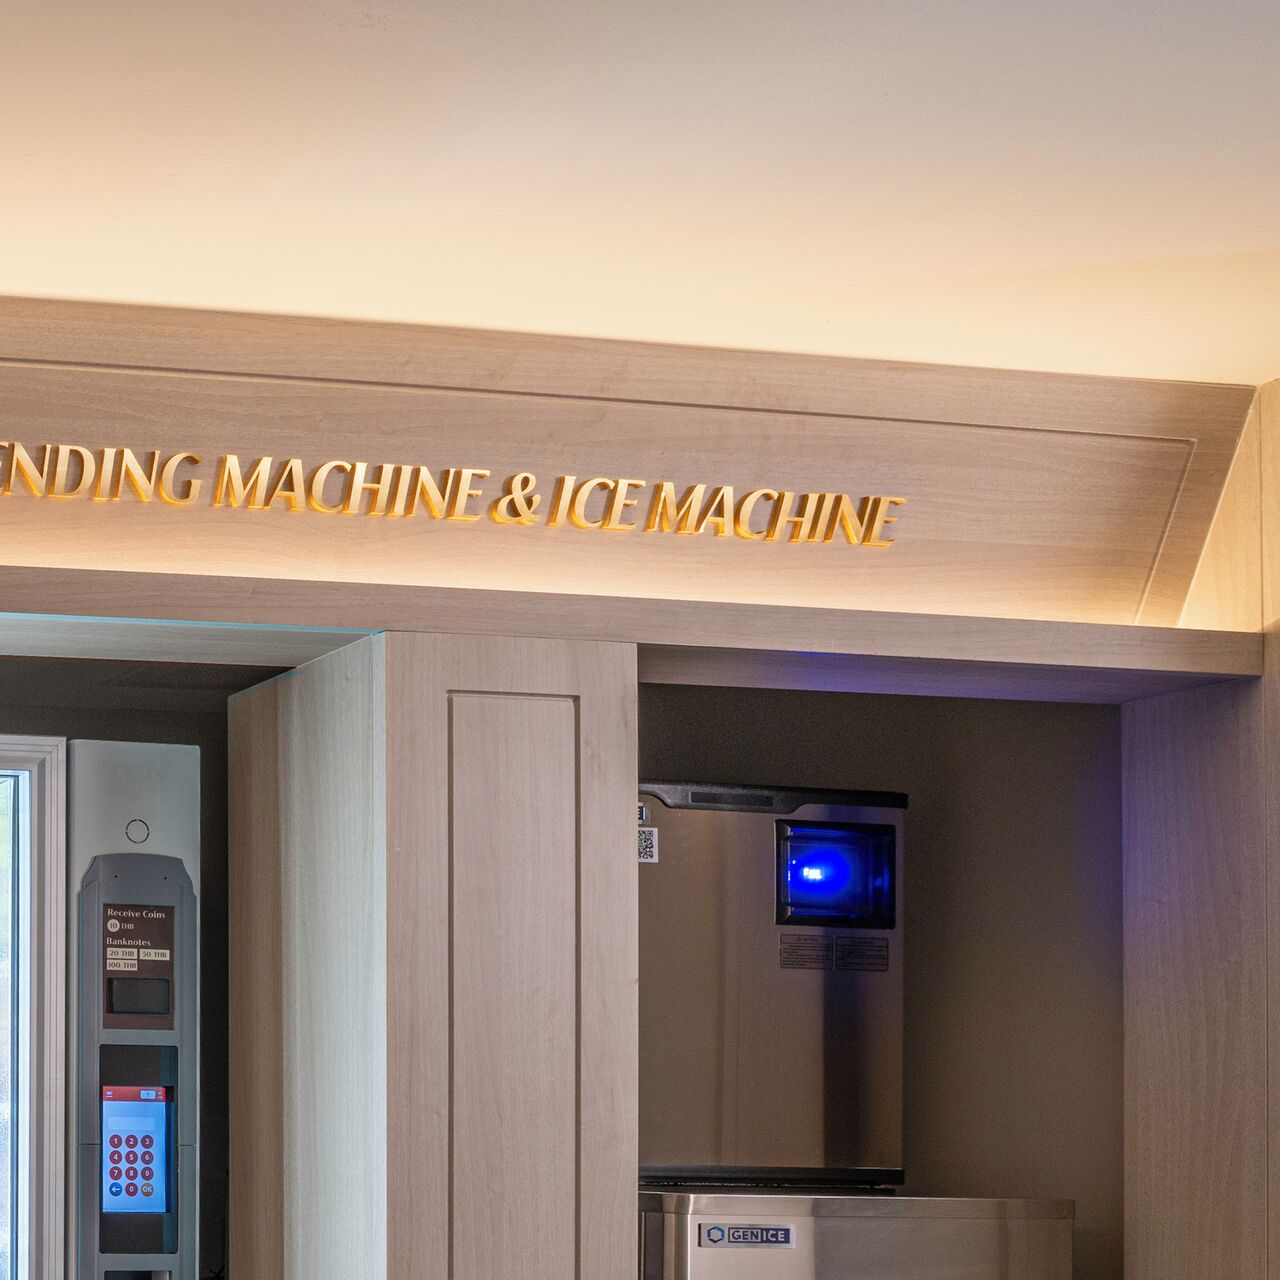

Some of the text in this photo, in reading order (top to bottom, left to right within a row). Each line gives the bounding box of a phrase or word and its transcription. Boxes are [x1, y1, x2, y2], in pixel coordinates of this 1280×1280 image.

[215, 454, 491, 522] MACHINE
[492, 471, 542, 526] &
[548, 474, 646, 532] ICE
[646, 480, 907, 548] MACHINE
[107, 908, 166, 919] Receive Coins
[106, 937, 152, 946] Banknotes
[731, 1229, 786, 1241] GENICE
